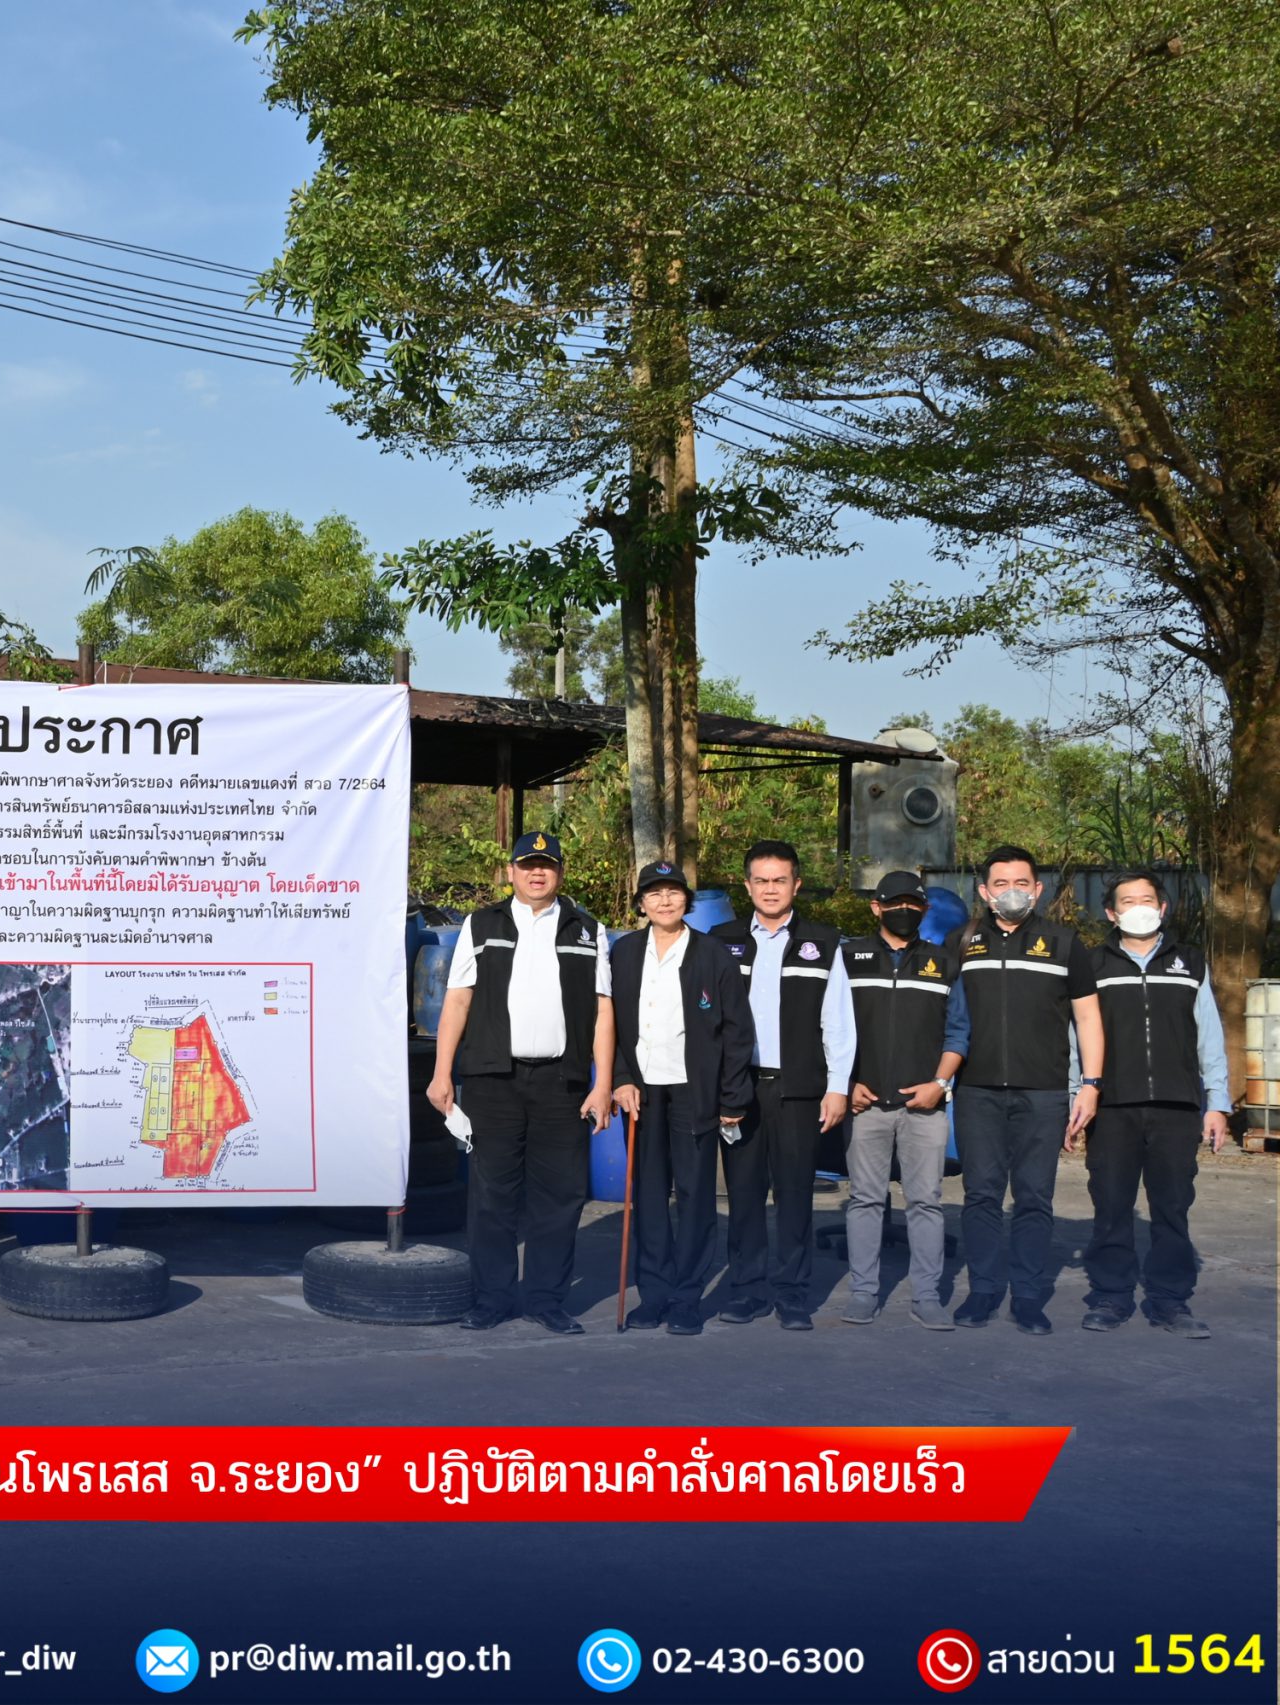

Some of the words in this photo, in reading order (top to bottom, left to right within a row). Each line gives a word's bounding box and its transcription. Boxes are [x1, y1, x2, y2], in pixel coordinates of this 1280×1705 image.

[180, 771, 297, 789] คดีหมายเลขแดงที่
[339, 778, 385, 790] 7/2564
[282, 800, 316, 815] จำกัด
[90, 823, 284, 846] และมีกรมโรงงานอุตสาหกรรม
[221, 851, 266, 866] ข้างต้น
[269, 872, 360, 893] โดยเด็ดขาด
[172, 901, 351, 922] ความผิดฐานทำให้เสียทรัพย์
[104, 970, 137, 978] LAYOUT
